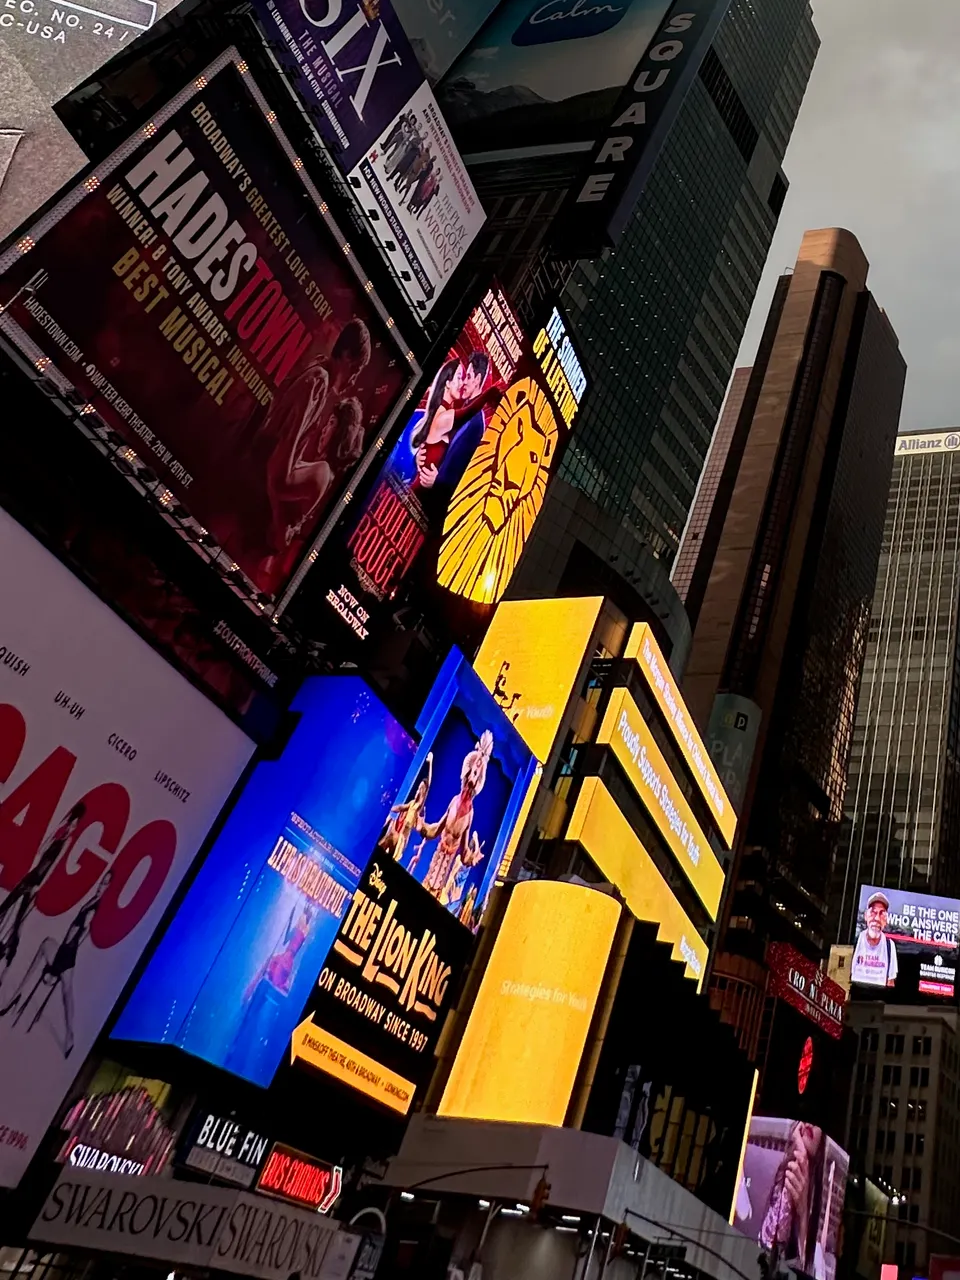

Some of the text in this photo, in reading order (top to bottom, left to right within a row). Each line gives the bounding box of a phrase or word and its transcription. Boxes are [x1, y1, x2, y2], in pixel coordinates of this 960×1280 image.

[0, 13, 67, 44] C-USA
[51, 9, 84, 30] NO.
[312, 54, 344, 110] MUSICAL
[576, 12, 697, 204] SQUARE
[190, 101, 333, 322] BROADWAY'S GREATEST LOVE STORY
[124, 129, 313, 388] HADESTOWN
[105, 183, 274, 407] WINNER! 8 TONY INCLUDING
[22, 295, 85, 364] HADESTOWN.COM
[111, 246, 237, 407] BEST MUSICAL
[532, 327, 579, 430] OF A LIFETIME
[545, 306, 587, 404] THE SUMMER
[898, 438, 942, 451] Allianz
[326, 589, 369, 641] BROADWAY
[338, 584, 359, 610] NOW
[356, 605, 370, 623] ON
[0, 646, 31, 677] QUISH
[107, 732, 138, 762] CICERO
[153, 769, 191, 804] LIPSCHITZ
[886, 912, 959, 934] WHO ANSWERS
[902, 904, 959, 923] BE THE ONE
[912, 927, 933, 942] THE
[342, 889, 452, 1012] THE LION KING
[318, 966, 429, 1054] ON BROADWAY SINCE 1997
[820, 992, 842, 1021] PLAZA
[196, 1113, 269, 1166] BLUE FIN
[41, 1181, 229, 1248] SWAROVSKI
[218, 1202, 336, 1278] SWAROVSKI
